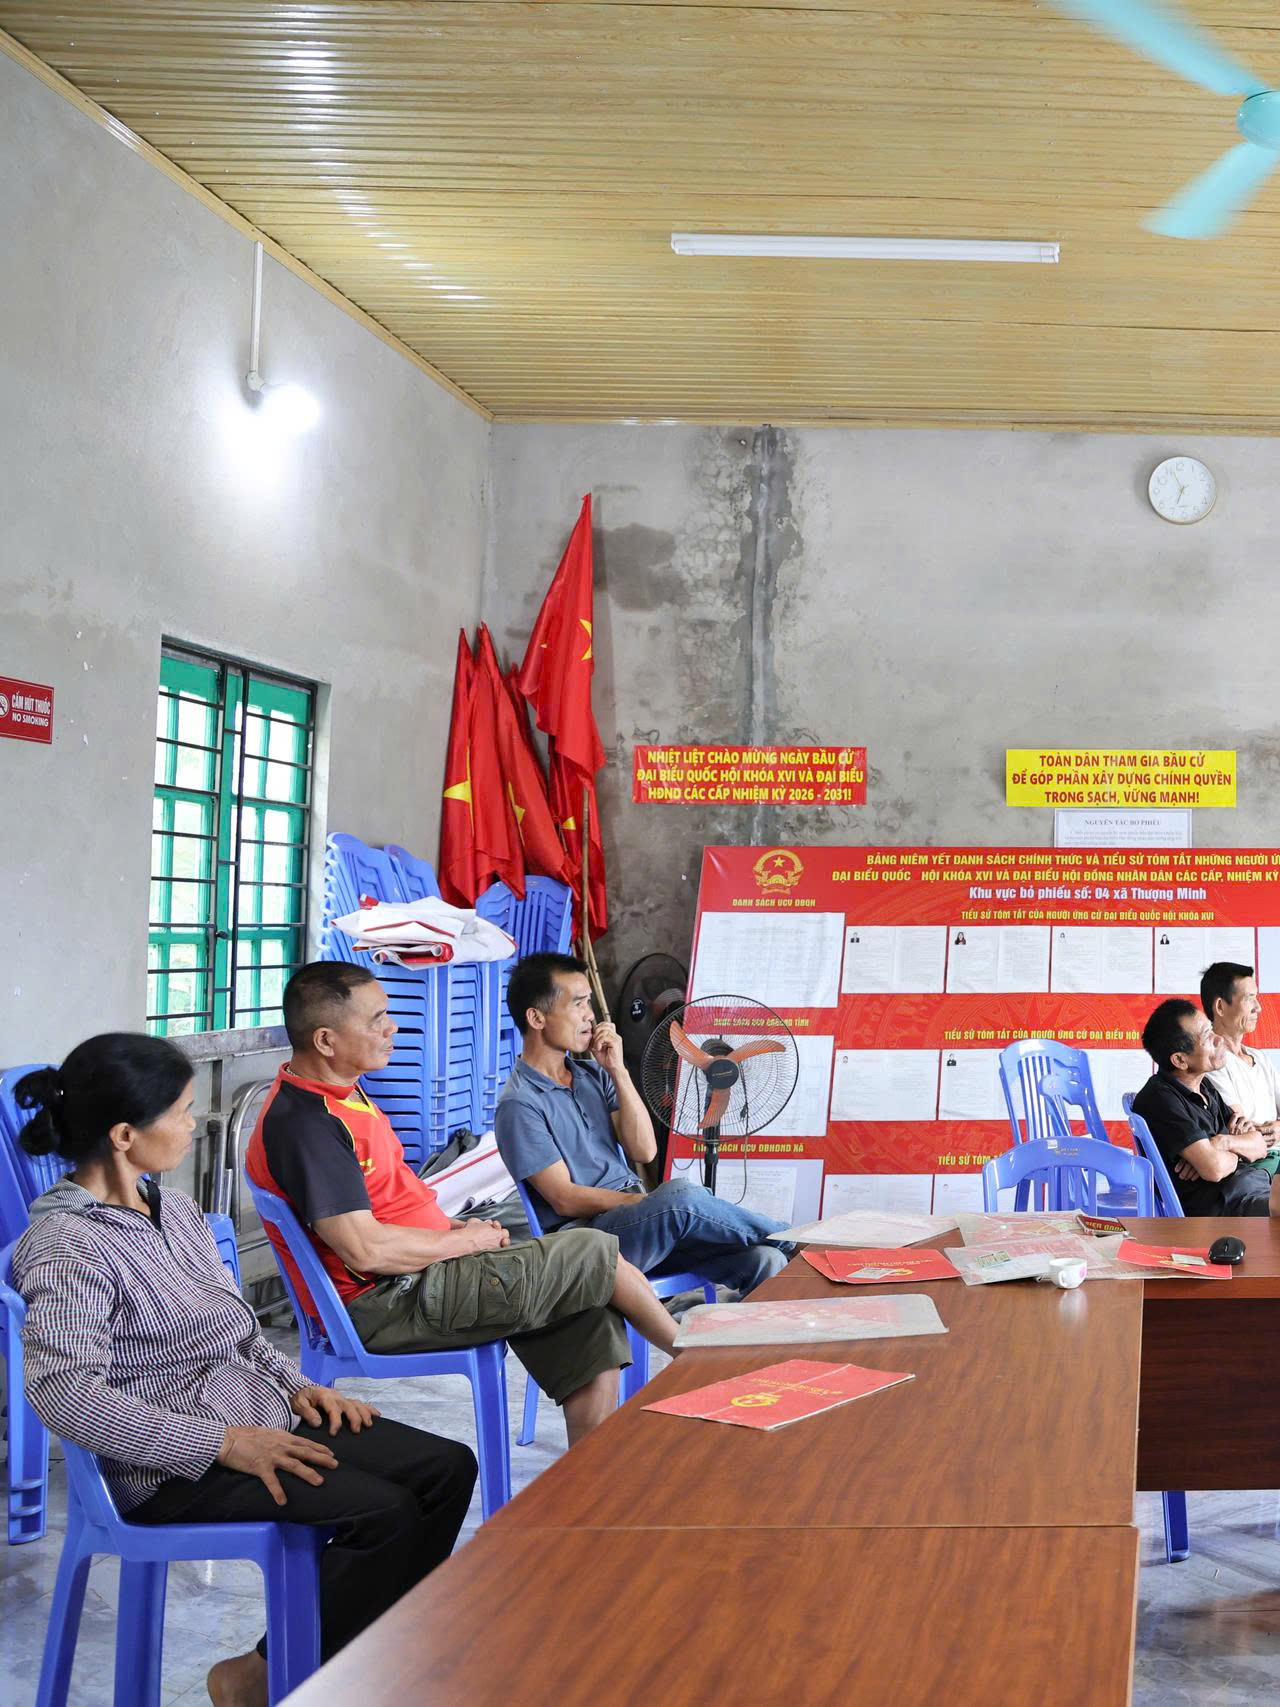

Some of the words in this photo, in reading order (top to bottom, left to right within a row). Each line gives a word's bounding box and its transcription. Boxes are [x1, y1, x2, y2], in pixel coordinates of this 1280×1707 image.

[12, 712, 21, 722] NO
[22, 714, 49, 727] SMOKING
[648, 750, 680, 765] NHIỆT
[684, 750, 704, 765] LIỆT
[708, 750, 739, 764] CHÀO
[742, 750, 777, 764] MỪNG
[781, 750, 809, 765] NGÀY
[813, 748, 835, 765] BẦU
[1039, 753, 1072, 767] TOÀN
[1075, 753, 1100, 767] DÂN
[1103, 755, 1137, 767] THAM
[1140, 755, 1159, 767] GIA
[1163, 752, 1187, 767] BẦU
[1189, 752, 1206, 767] CỬ
[637, 769, 656, 785] ĐẠI
[660, 766, 684, 782] BIỂU
[687, 767, 718, 783] QUỐC
[720, 768, 741, 784] HỘI
[744, 769, 774, 782] KHÓA
[778, 770, 795, 782] XVI
[799, 769, 813, 782] VÀ
[816, 770, 836, 785] ĐẠI
[840, 766, 863, 783] BIỂU
[1012, 770, 1027, 785] ĐỂ
[1030, 770, 1054, 785] GÓP
[1057, 770, 1089, 785] PHẦN
[1092, 771, 1114, 785] XÂY
[1118, 773, 1151, 788] DỰNG
[1154, 771, 1190, 785] CHÍNH
[1193, 770, 1232, 787] QUYỀN
[648, 788, 681, 800] HĐND
[684, 786, 705, 800] CÁC
[708, 784, 730, 800] CẤP
[733, 786, 769, 801] NHIỆM
[789, 788, 814, 800] 2026
[824, 788, 852, 800] 2031!
[1044, 792, 1084, 803] TRONG
[1087, 792, 1120, 806] SẠCH,
[1123, 788, 1158, 803] VỮNG
[1161, 792, 1200, 806] MẠNH!
[867, 852, 897, 865] BẢNG
[900, 853, 928, 865] NIÊM
[932, 852, 951, 865] YẾT
[954, 855, 983, 865] DANH
[986, 853, 1015, 865] SÁCH
[1019, 853, 1052, 865] CHÍNH
[1056, 853, 1082, 865] THỨC
[1086, 853, 1099, 865] VÀ
[1103, 852, 1125, 865] TIỂU
[1129, 852, 1144, 865] SỬ
[1147, 853, 1169, 865] TÓM
[1173, 852, 1191, 865] TẮT
[1195, 854, 1232, 865] NHỮNG
[1235, 854, 1268, 865] NGƯỜI
[832, 870, 850, 883] ĐẠI
[854, 868, 879, 881] BIỂU
[882, 868, 911, 881] QUỐC
[922, 870, 940, 883] HỘI
[943, 869, 972, 881] KHÓA
[975, 871, 993, 881] XVI
[996, 869, 1010, 881] VÀ
[1013, 871, 1031, 883] ĐẠI
[1035, 868, 1059, 881] BIỂU
[1062, 870, 1081, 883] HỘI
[1117, 870, 1147, 881] NHÂN
[1151, 870, 1173, 881] DÂN
[1176, 870, 1197, 881] CÁC
[1227, 870, 1262, 883] NHIỆM
[970, 886, 992, 899] Khu
[996, 888, 1017, 901] vực
[1020, 886, 1034, 899] bỏ
[1038, 886, 1071, 900] phiếu
[1074, 886, 1091, 899] số:
[1095, 888, 1110, 899] 04
[1114, 888, 1128, 899] xã
[1131, 888, 1173, 901] Thượng
[1177, 888, 1206, 899] Minh
